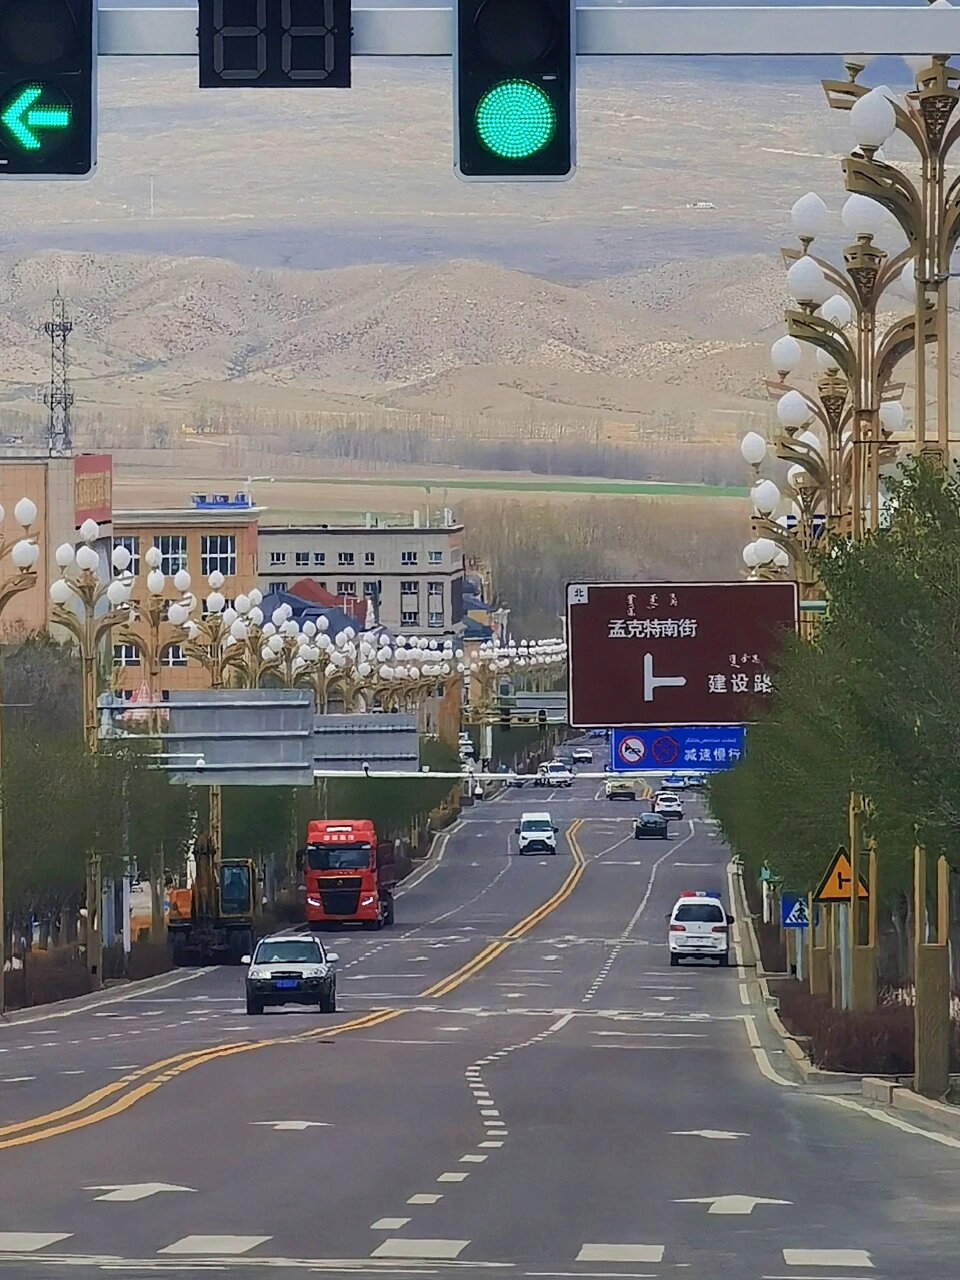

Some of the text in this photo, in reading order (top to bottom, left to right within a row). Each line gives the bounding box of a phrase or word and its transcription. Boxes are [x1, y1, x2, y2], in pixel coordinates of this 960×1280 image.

[574, 588, 585, 598] 北
[608, 618, 697, 638] 孟克特南街
[708, 673, 772, 693] 建设路
[684, 747, 741, 762] 减速慢行
